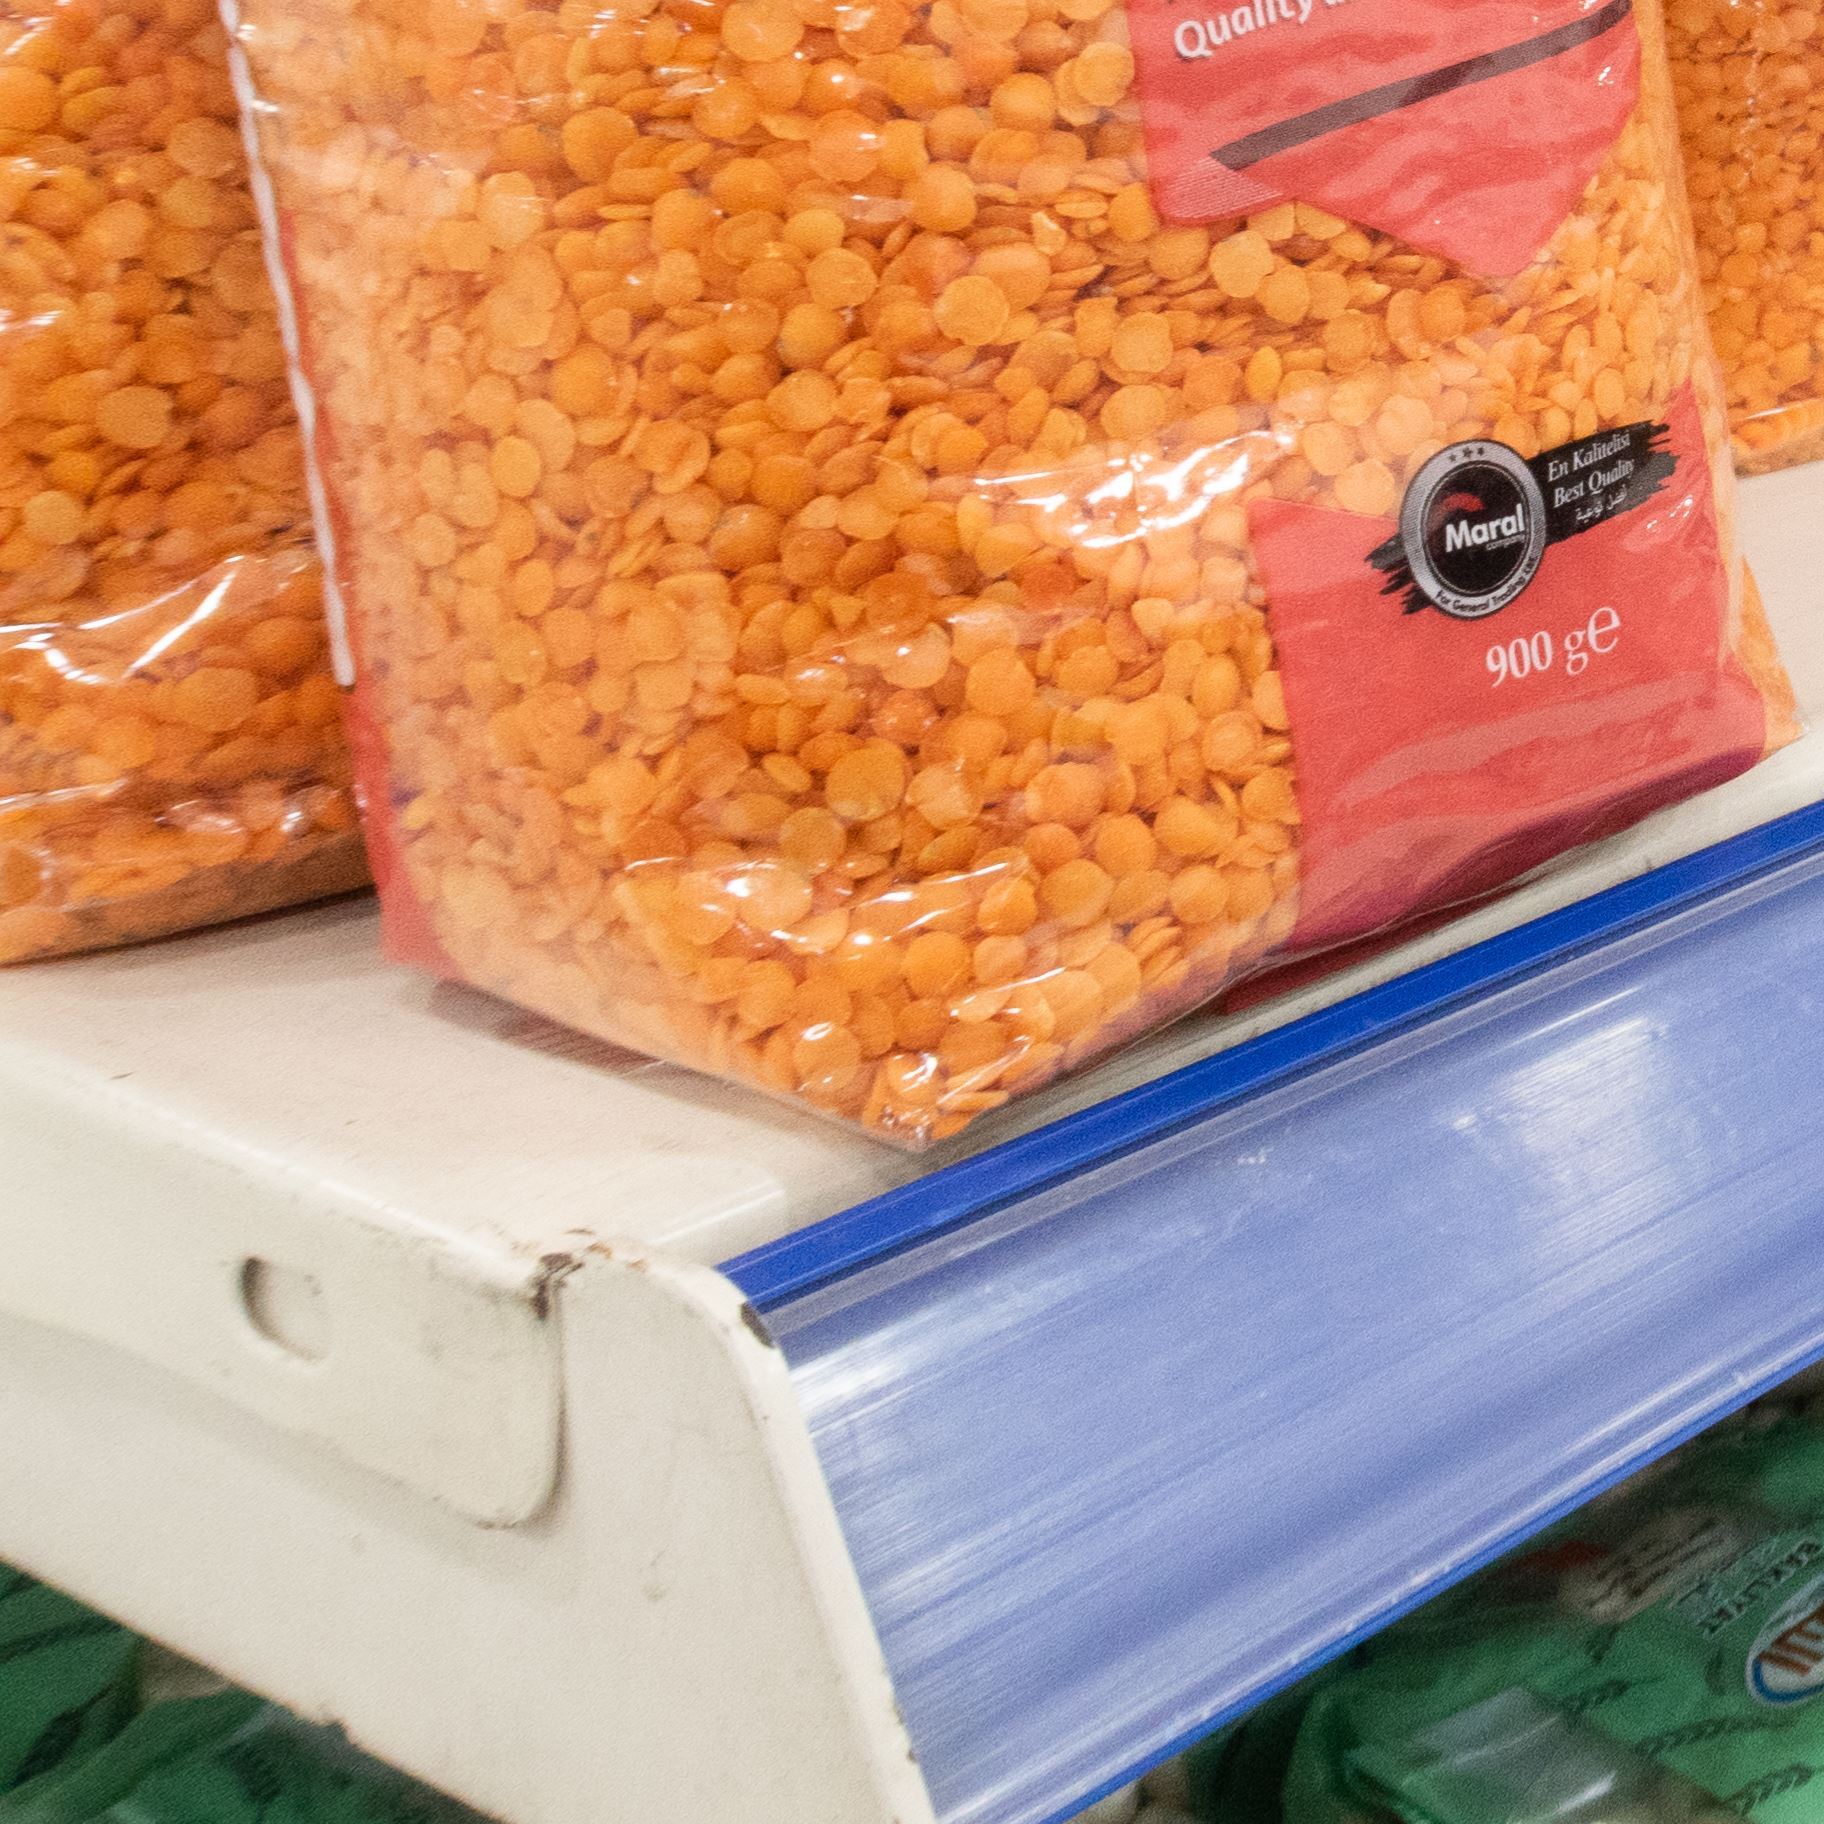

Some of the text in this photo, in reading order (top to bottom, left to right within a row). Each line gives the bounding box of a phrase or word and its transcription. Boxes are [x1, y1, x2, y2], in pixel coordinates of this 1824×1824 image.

[1548, 431, 1631, 483] En Kalitelisi
[1553, 459, 1634, 509] Best Quality
[1445, 503, 1526, 553] Maral
[1452, 596, 1491, 613] General
[1485, 630, 1554, 688] 900
